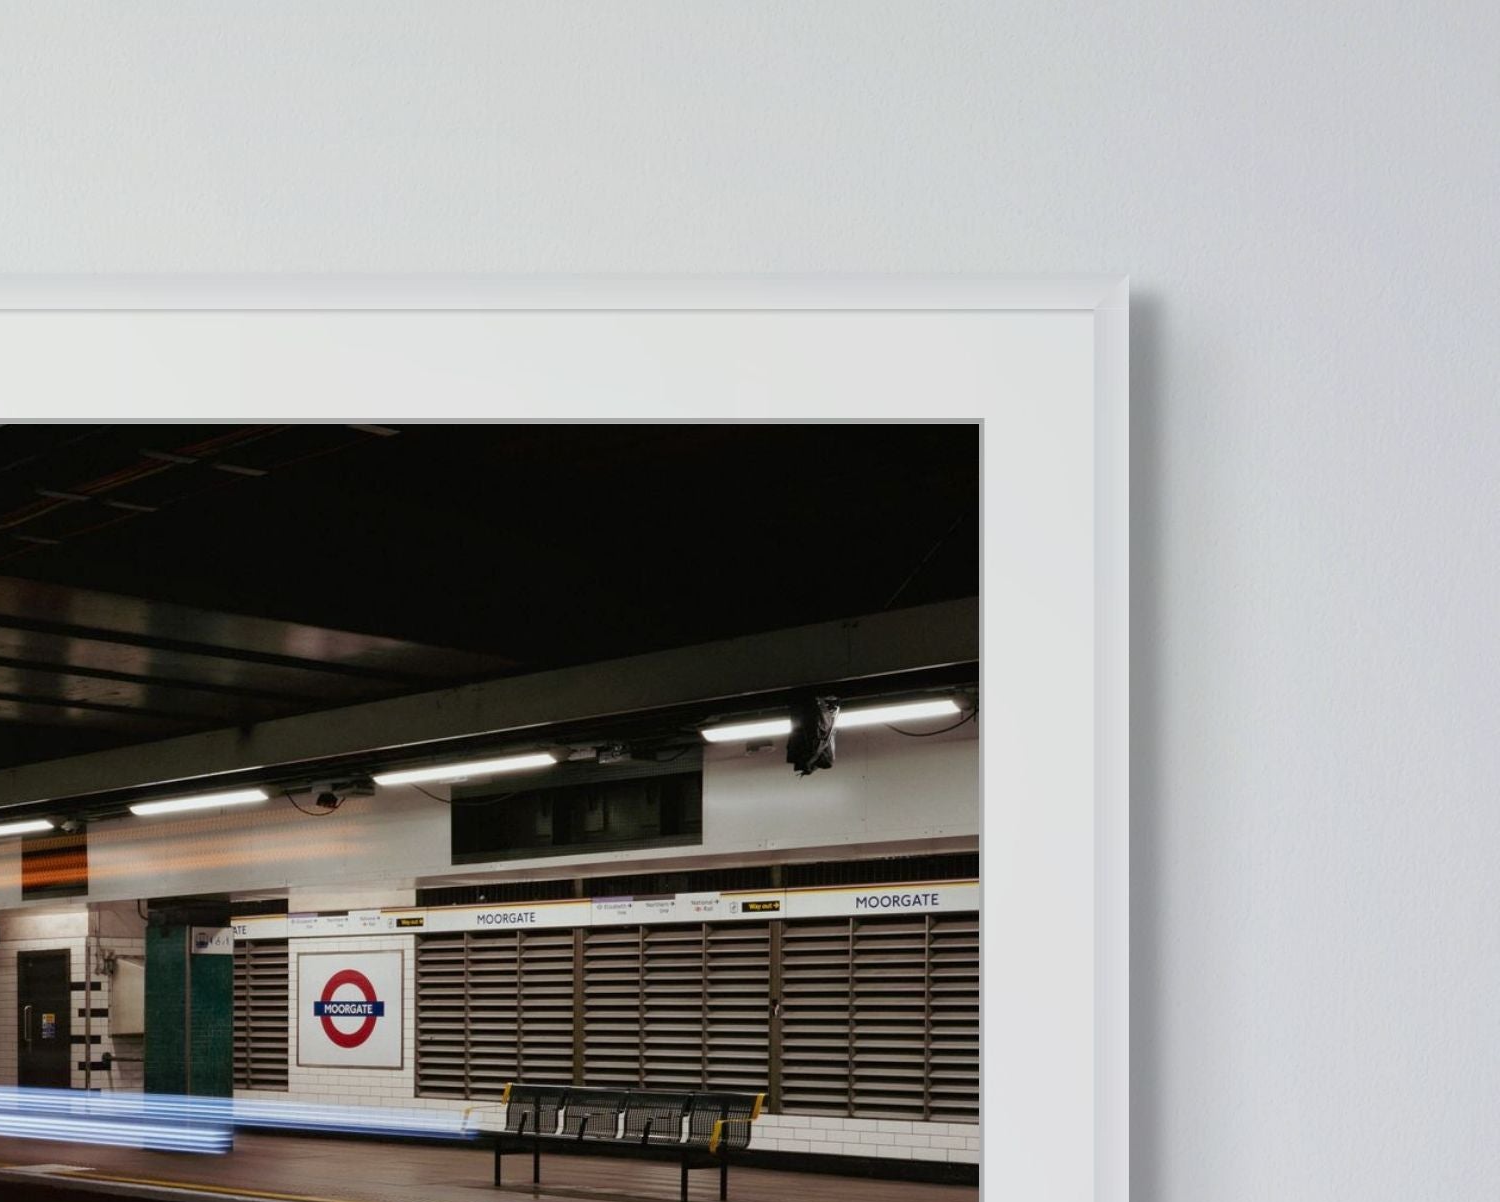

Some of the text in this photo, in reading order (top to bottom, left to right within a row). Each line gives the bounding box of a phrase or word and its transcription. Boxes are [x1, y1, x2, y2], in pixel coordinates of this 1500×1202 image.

[855, 893, 940, 909] MOORGATE
[477, 912, 537, 925] MOORGATE
[324, 1003, 373, 1014] MOORGATE
